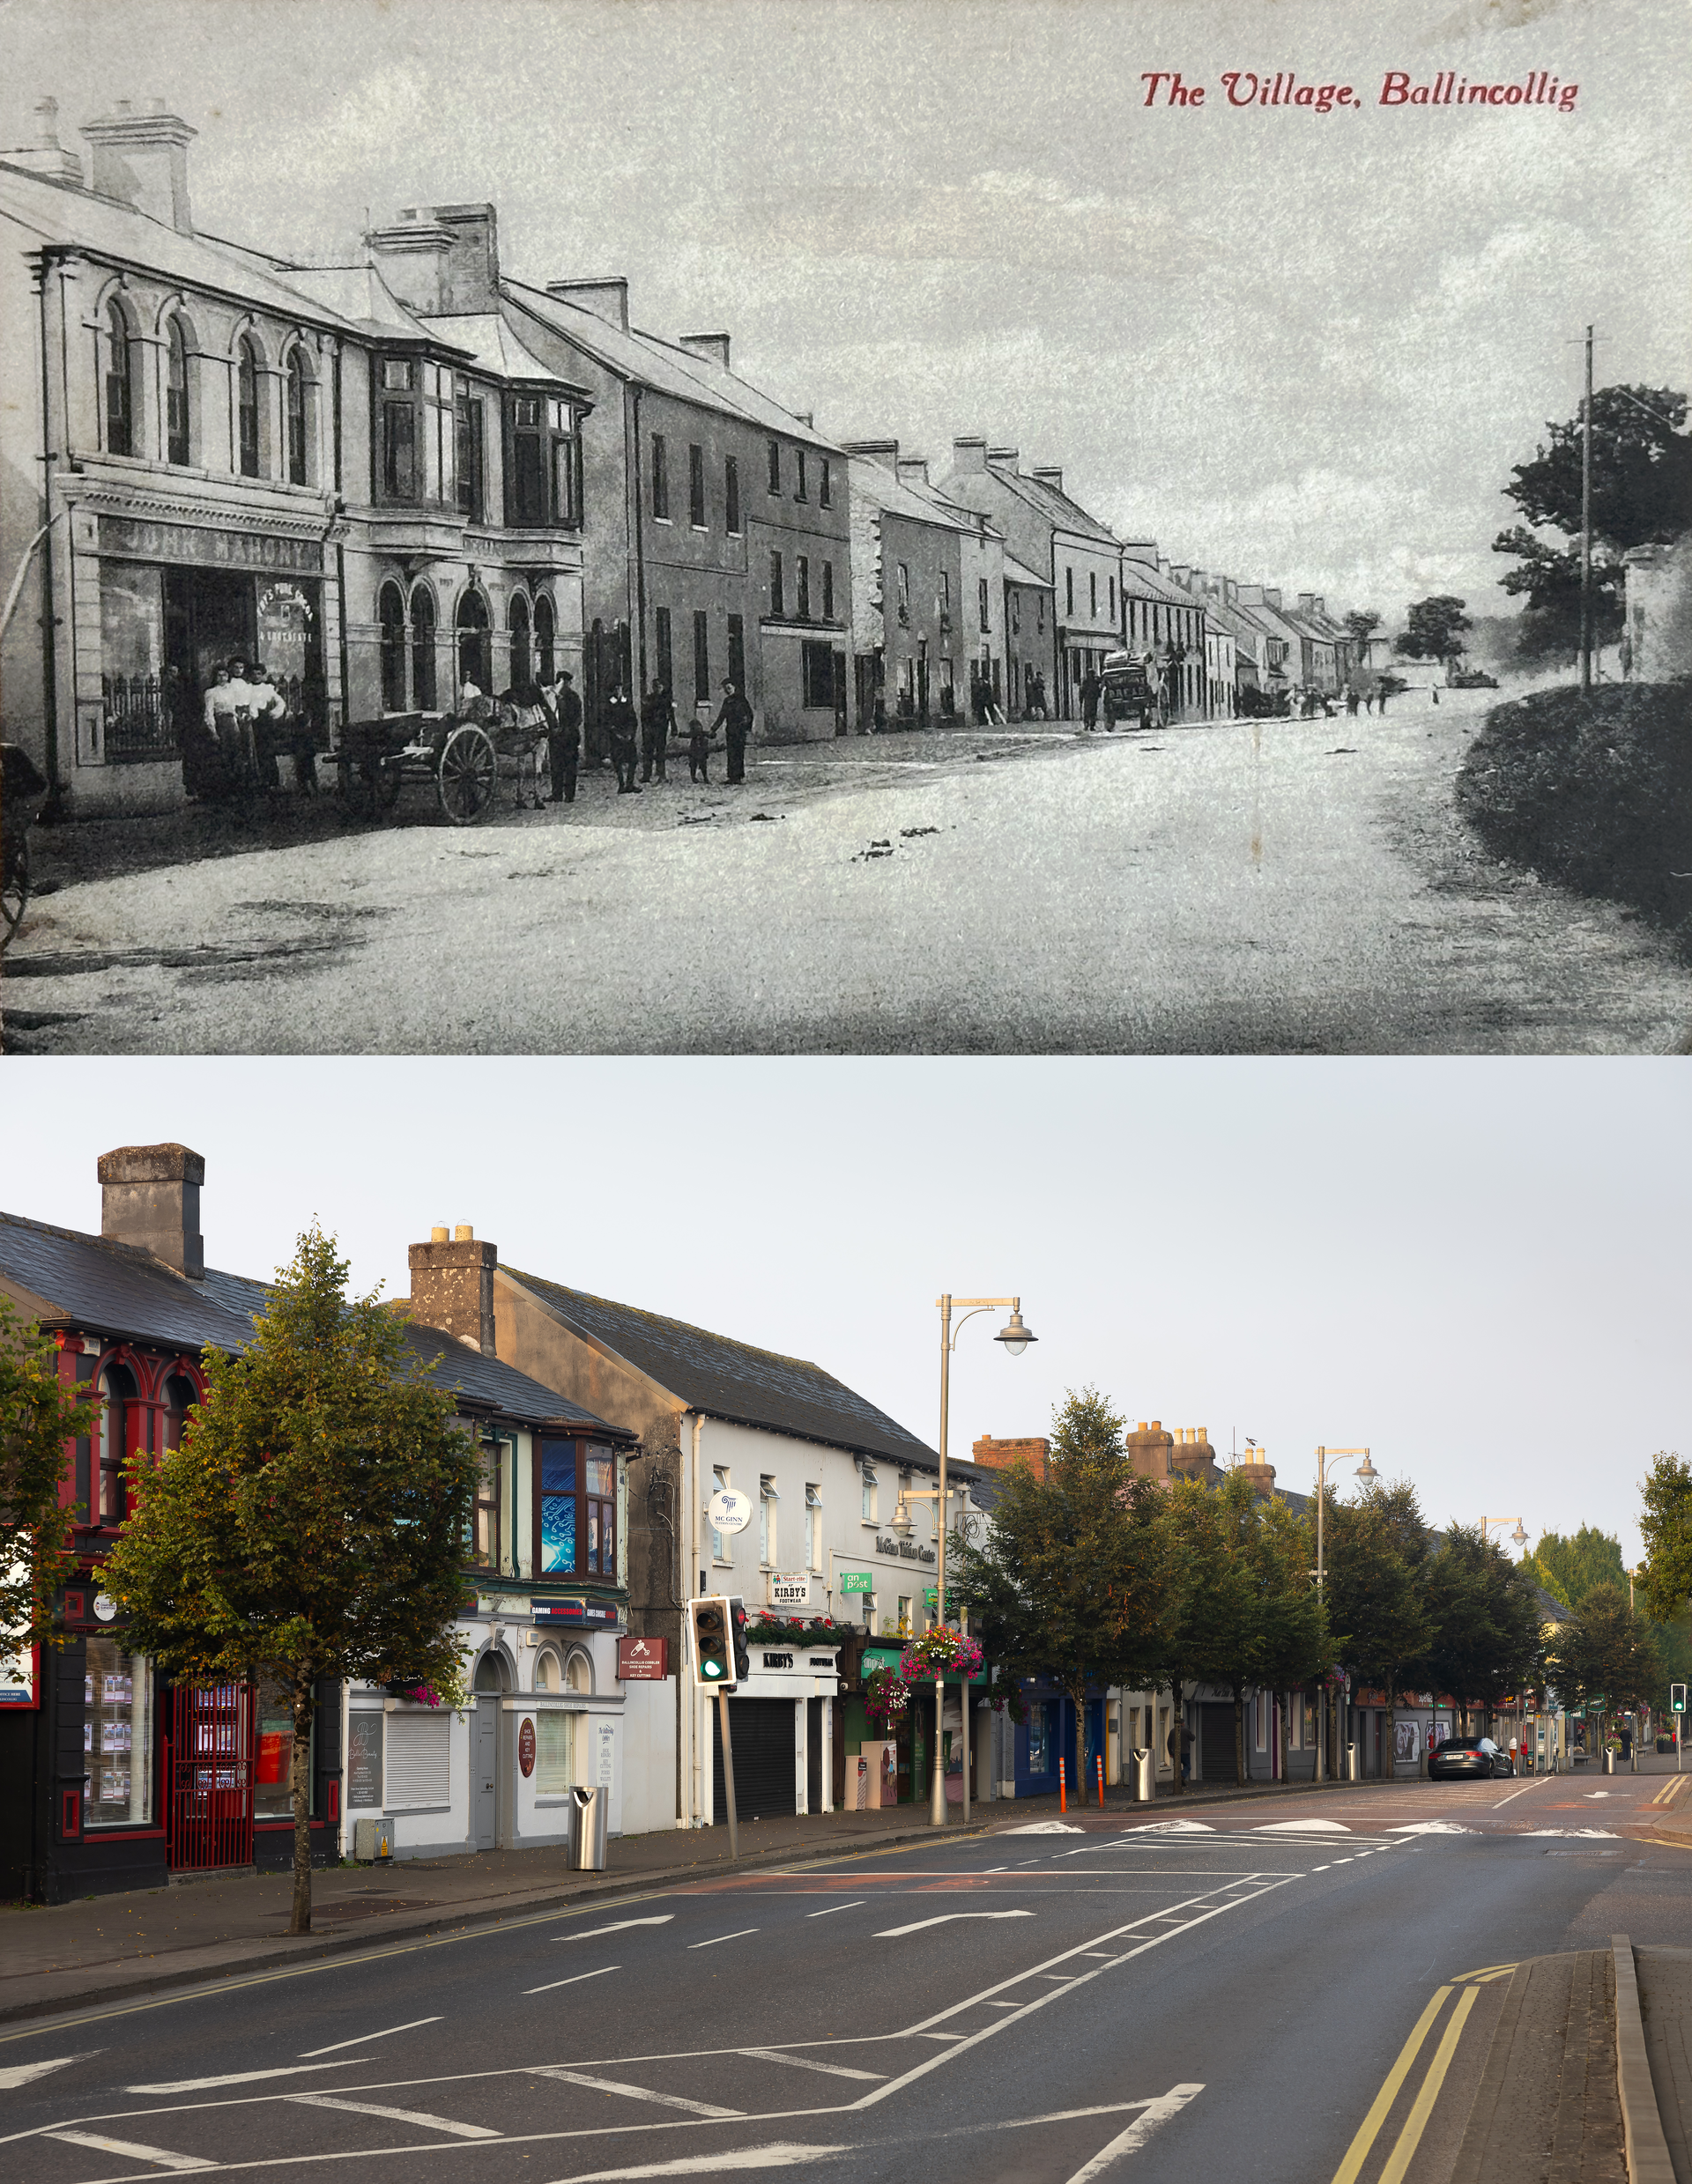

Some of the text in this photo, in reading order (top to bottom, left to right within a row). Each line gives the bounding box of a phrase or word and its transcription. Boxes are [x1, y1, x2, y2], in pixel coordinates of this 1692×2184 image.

[876, 1536, 899, 1556] McGinn
[775, 1586, 806, 1597] KIRBY'S
[847, 1581, 869, 1589] post
[762, 1652, 793, 1669] KIRBY'S
